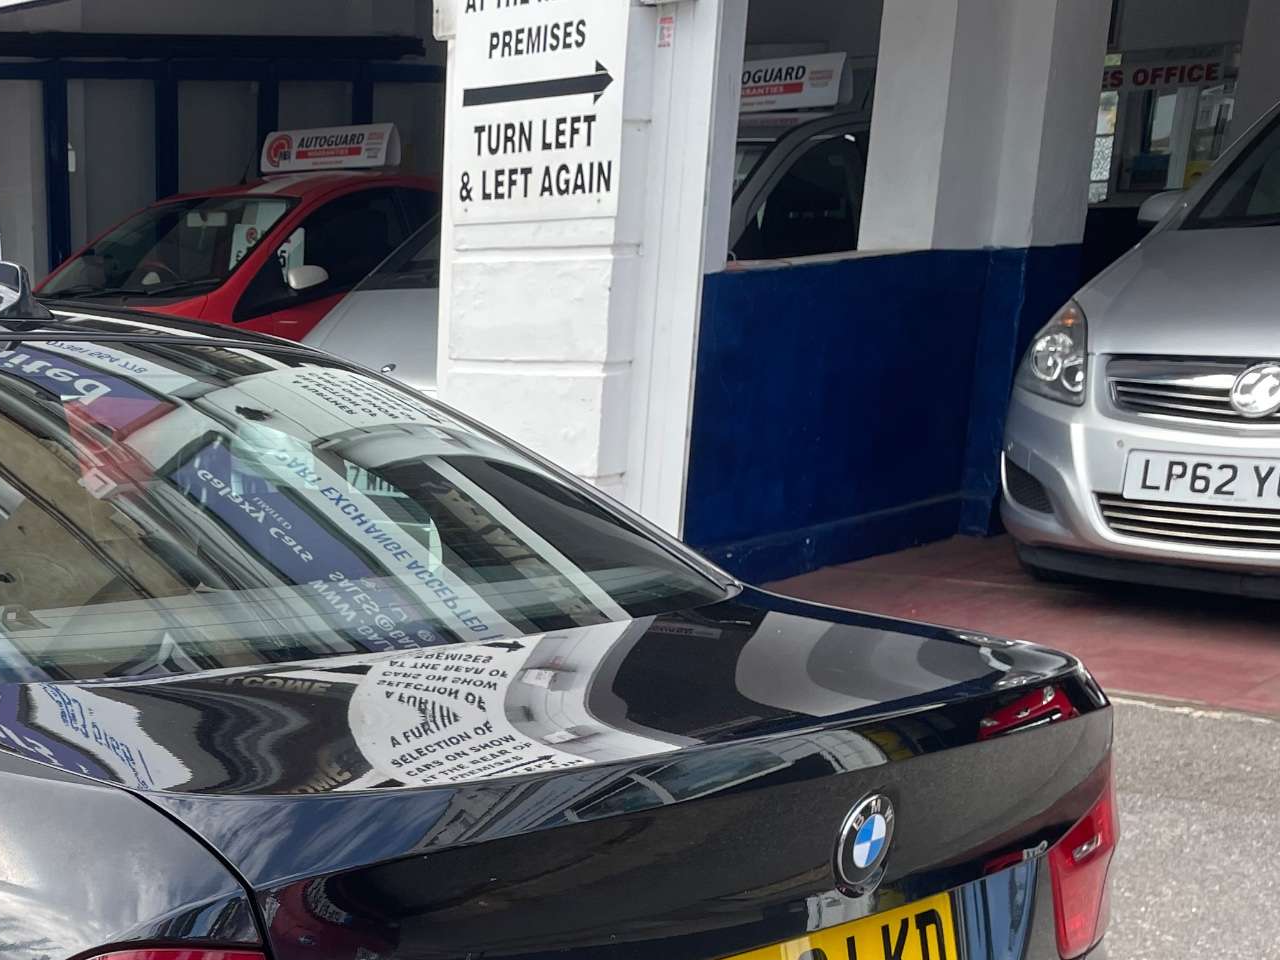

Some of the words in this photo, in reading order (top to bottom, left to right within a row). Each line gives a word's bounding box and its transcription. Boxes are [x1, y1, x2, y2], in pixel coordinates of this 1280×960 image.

[488, 19, 587, 59] PREMISES
[741, 65, 807, 85] OGUARD
[1102, 69, 1124, 89] ES
[1132, 62, 1220, 86] OFFICE
[297, 132, 365, 148] AUTOGUARD
[474, 120, 533, 157] TURN
[541, 114, 597, 151] LEFT
[459, 171, 473, 202] &
[481, 166, 532, 200] LEFT
[539, 160, 613, 198] AGAIN
[1140, 458, 1239, 497] LP62
[1252, 465, 1280, 498] Y
